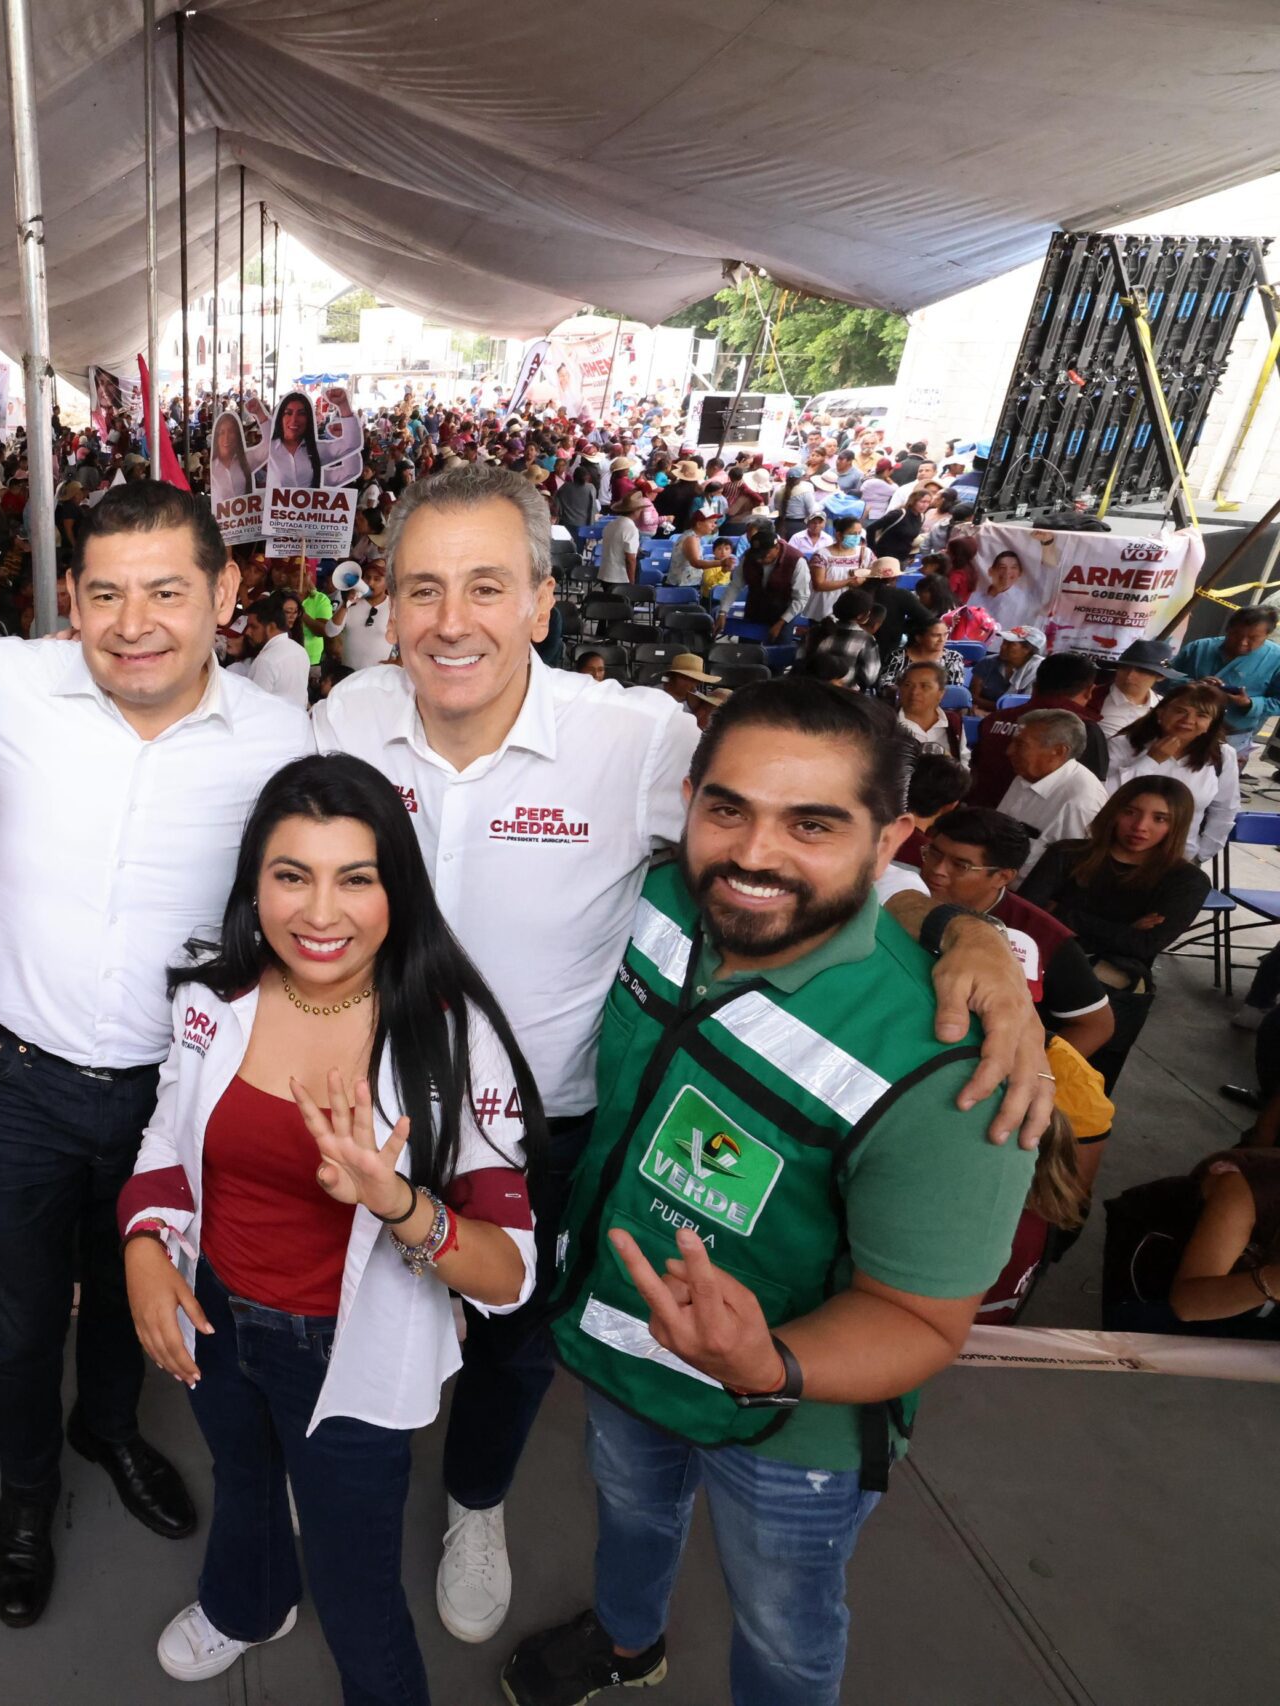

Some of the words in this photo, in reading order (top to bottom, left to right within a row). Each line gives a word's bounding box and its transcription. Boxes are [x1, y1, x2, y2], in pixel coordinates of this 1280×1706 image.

[216, 495, 264, 520] NOR
[271, 488, 350, 511] NORA
[219, 515, 263, 531] ESCAMIL
[270, 509, 349, 524] ESCAMILLA
[269, 521, 303, 529] DIPUTADA
[1086, 614, 1114, 624] AMOR
[515, 806, 564, 822] PEPE
[490, 819, 589, 836] CHEDRAUI
[185, 1006, 218, 1042] ORA
[654, 1149, 751, 1226] VERDE
